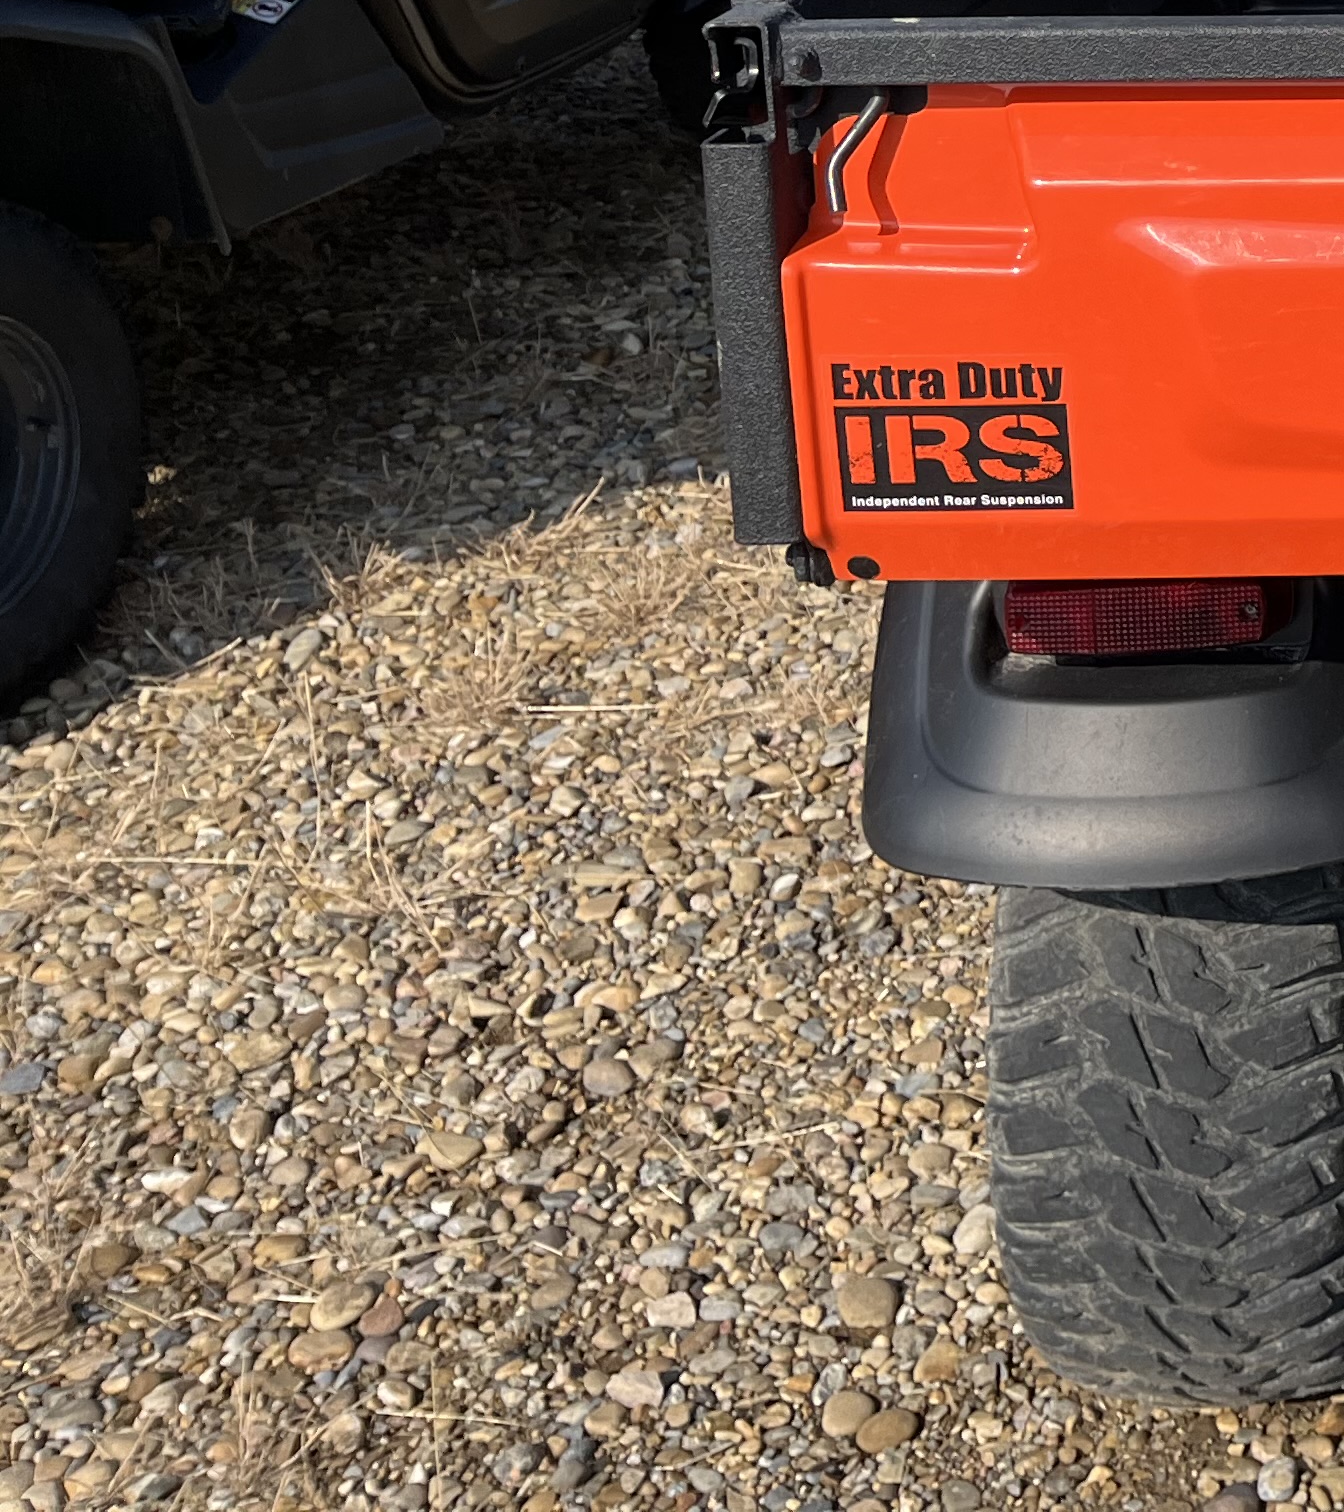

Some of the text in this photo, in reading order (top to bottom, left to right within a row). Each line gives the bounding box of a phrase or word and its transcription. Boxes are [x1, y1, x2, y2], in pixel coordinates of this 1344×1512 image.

[830, 361, 1063, 402] Extra Duty
[844, 414, 1065, 485] IRS
[851, 493, 1064, 509] Independent Rear Suspension
